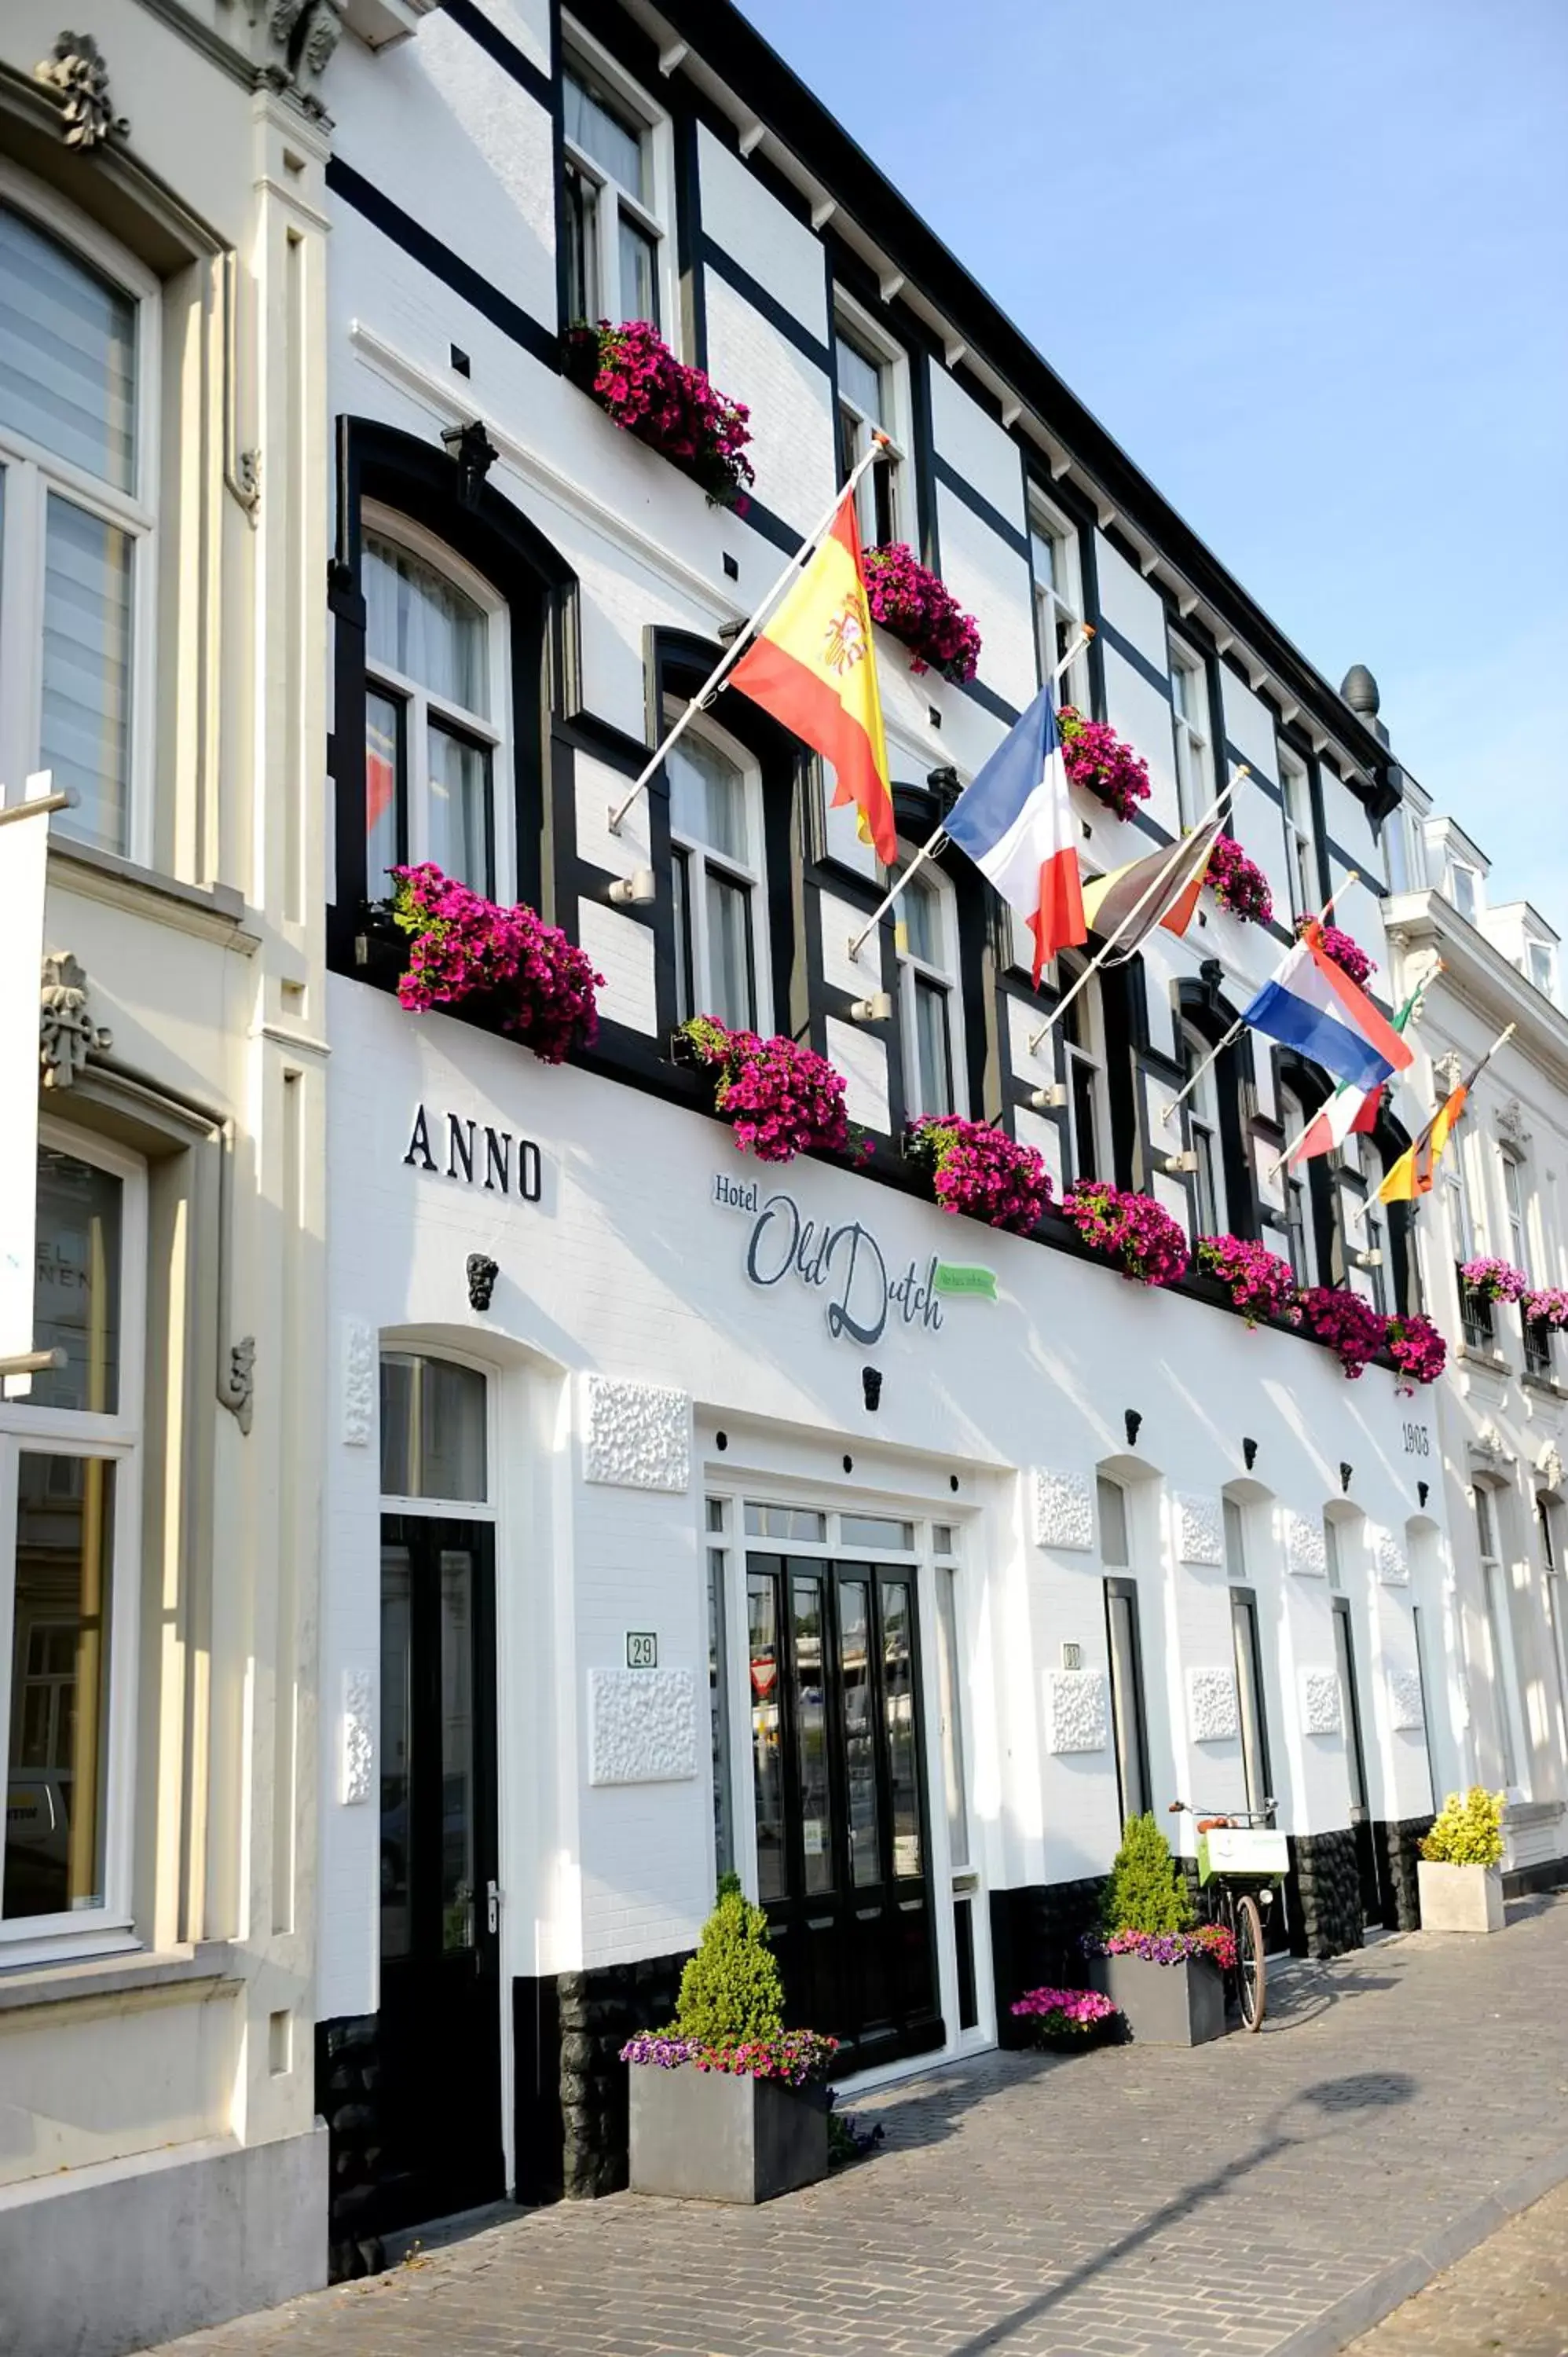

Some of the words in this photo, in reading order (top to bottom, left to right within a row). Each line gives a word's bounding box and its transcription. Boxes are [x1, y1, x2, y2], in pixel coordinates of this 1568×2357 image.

[404, 1103, 541, 1203] ANNO
[716, 1175, 757, 1212] Hotel
[747, 1194, 829, 1285] Old
[826, 1222, 943, 1346] Dutch
[633, 1637, 651, 1664] 29
